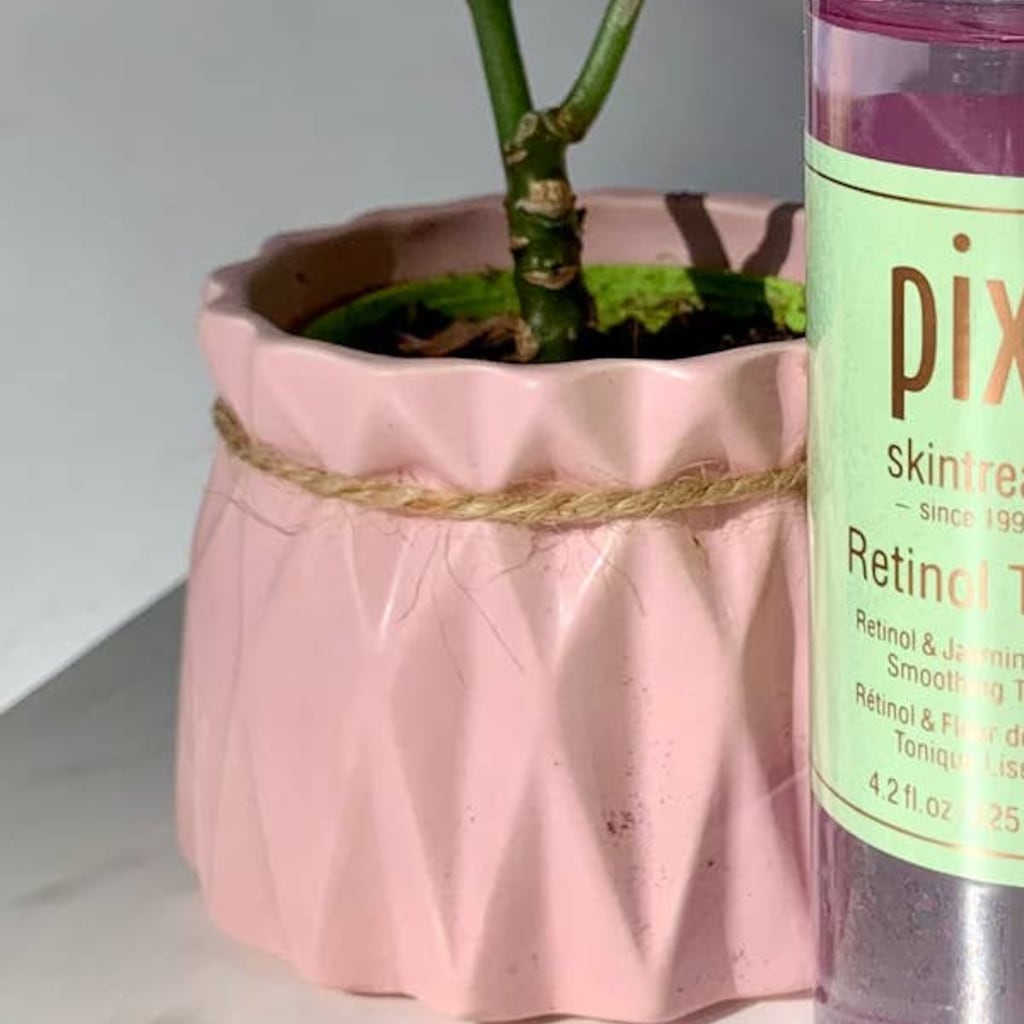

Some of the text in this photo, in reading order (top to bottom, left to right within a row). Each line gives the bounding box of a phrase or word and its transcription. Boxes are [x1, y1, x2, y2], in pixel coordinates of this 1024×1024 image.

[920, 502, 977, 528] since
[848, 526, 989, 612] Retinol
[856, 609, 916, 651] Retinol
[922, 632, 937, 656] &
[856, 682, 915, 726] Rétinol
[920, 708, 935, 732] &
[894, 730, 974, 771] Toniqu
[869, 771, 899, 805] 4.2
[980, 800, 1021, 833] 25
